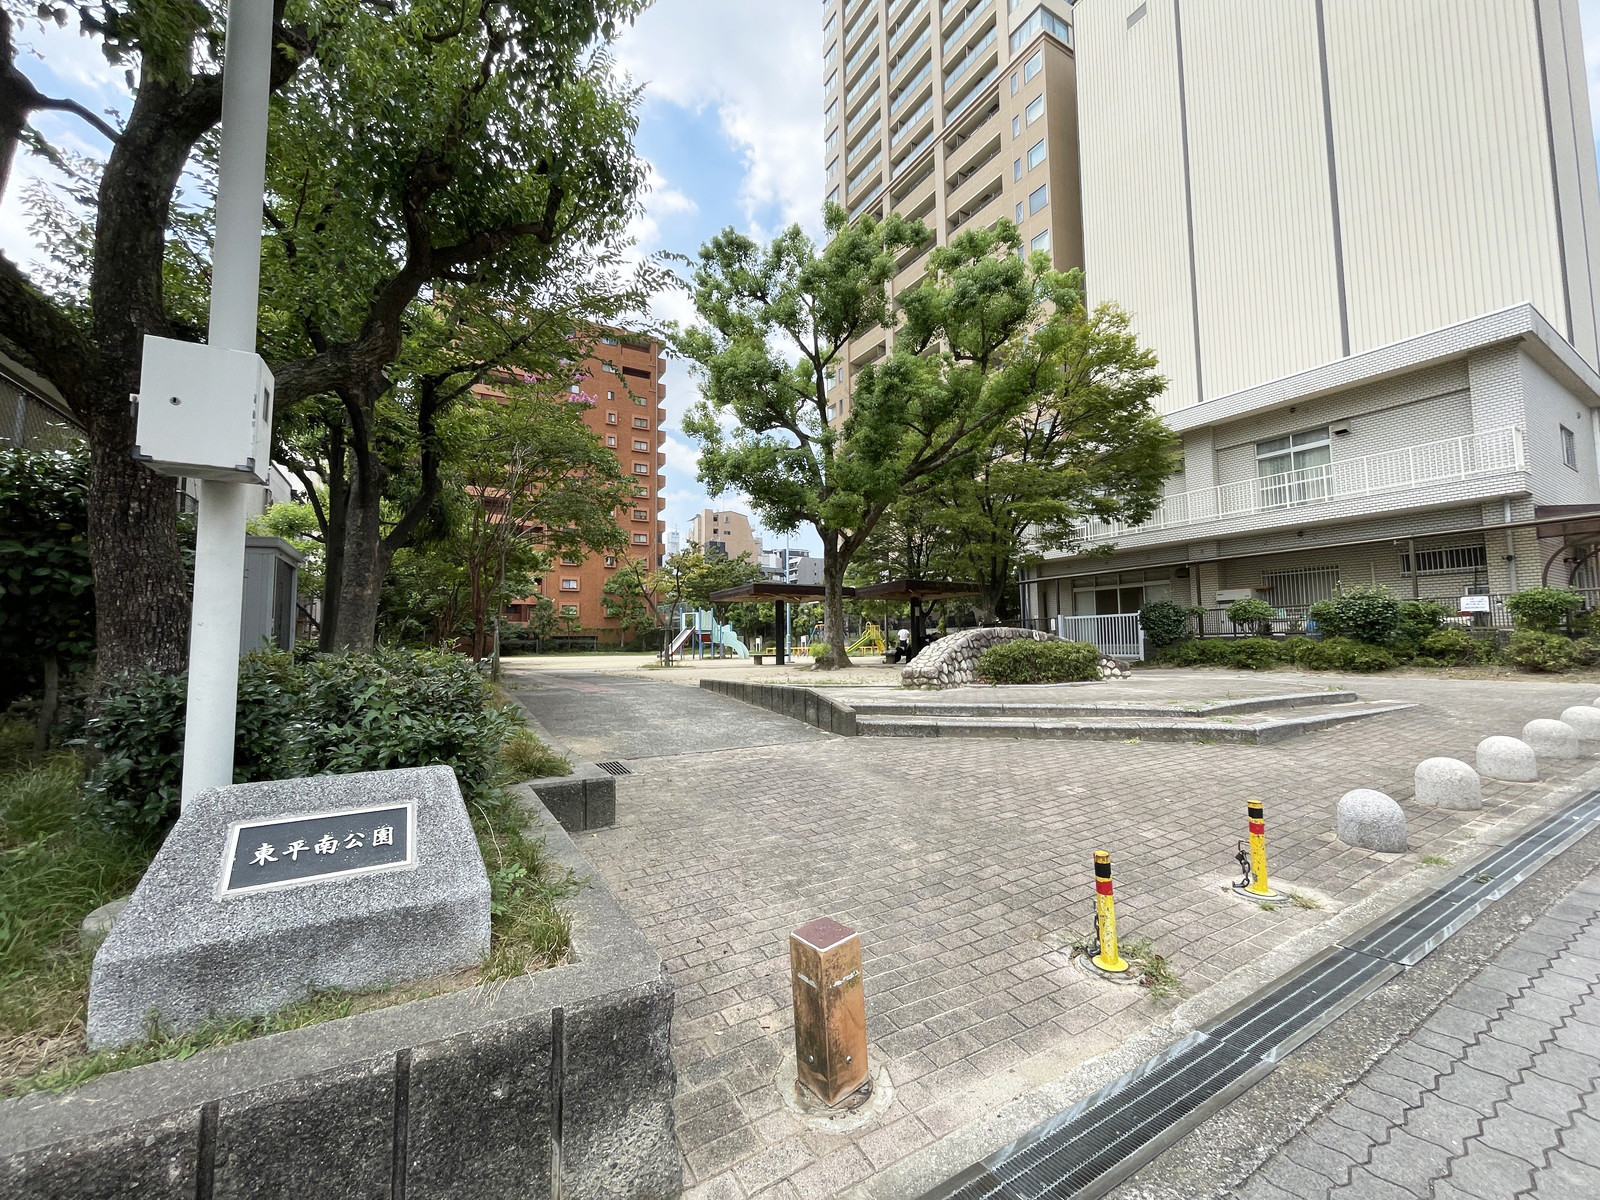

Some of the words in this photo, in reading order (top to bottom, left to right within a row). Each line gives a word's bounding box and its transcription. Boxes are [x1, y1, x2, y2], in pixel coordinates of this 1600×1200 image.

[249, 826, 394, 867] 東平南公園
